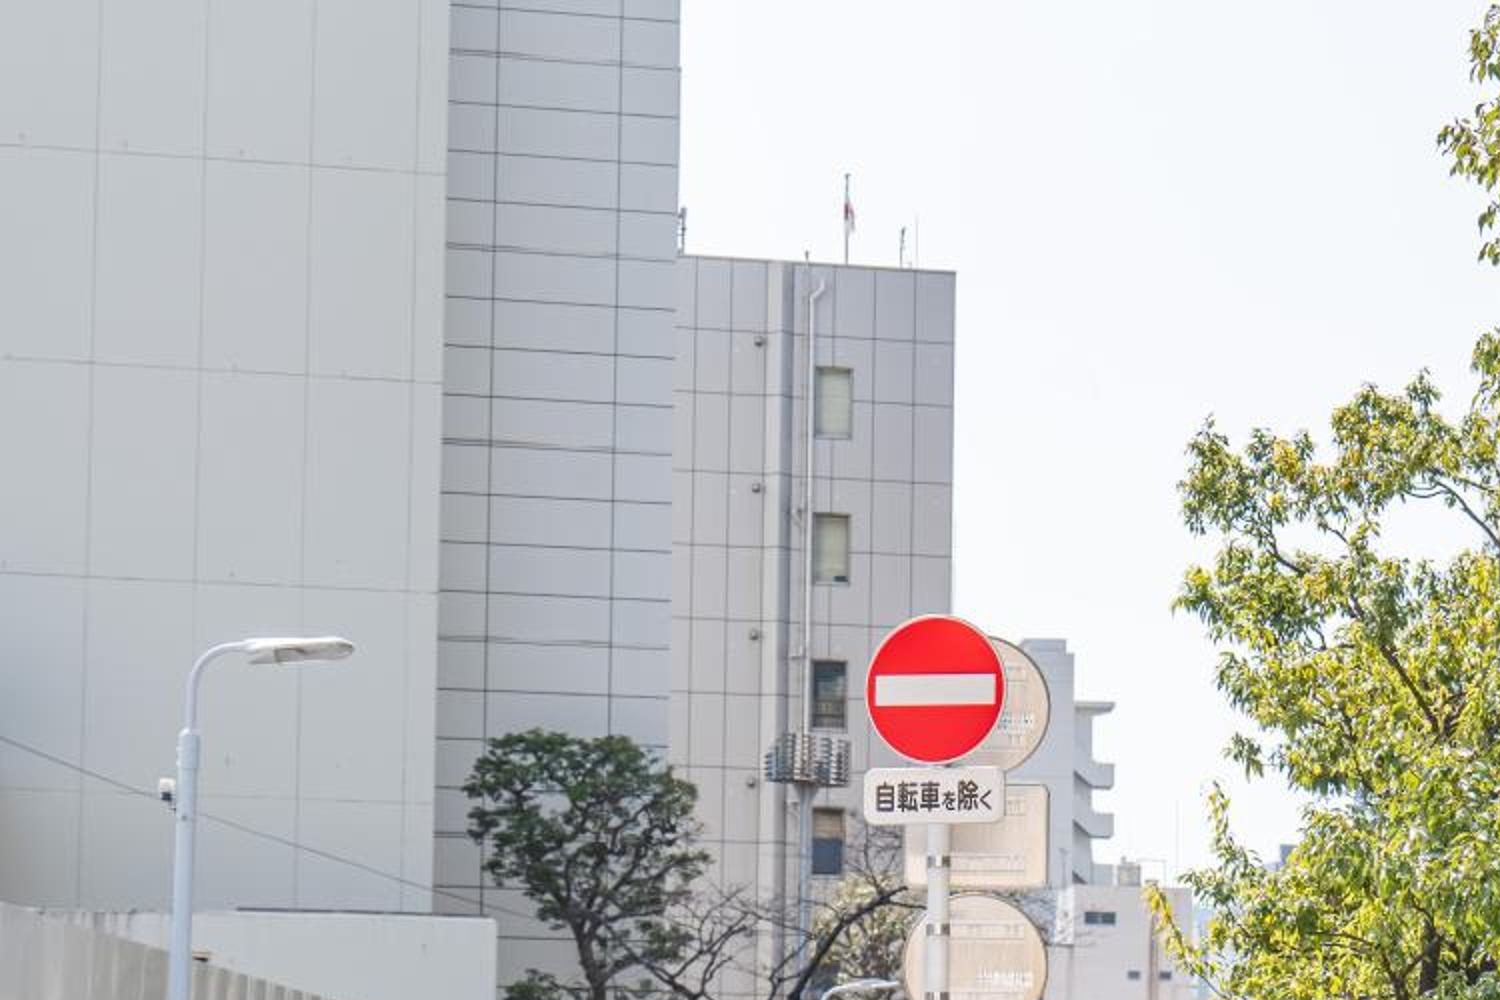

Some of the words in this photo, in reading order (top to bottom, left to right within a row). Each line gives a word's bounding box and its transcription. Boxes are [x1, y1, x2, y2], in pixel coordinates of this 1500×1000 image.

[876, 780, 993, 813] 自転車を除く
